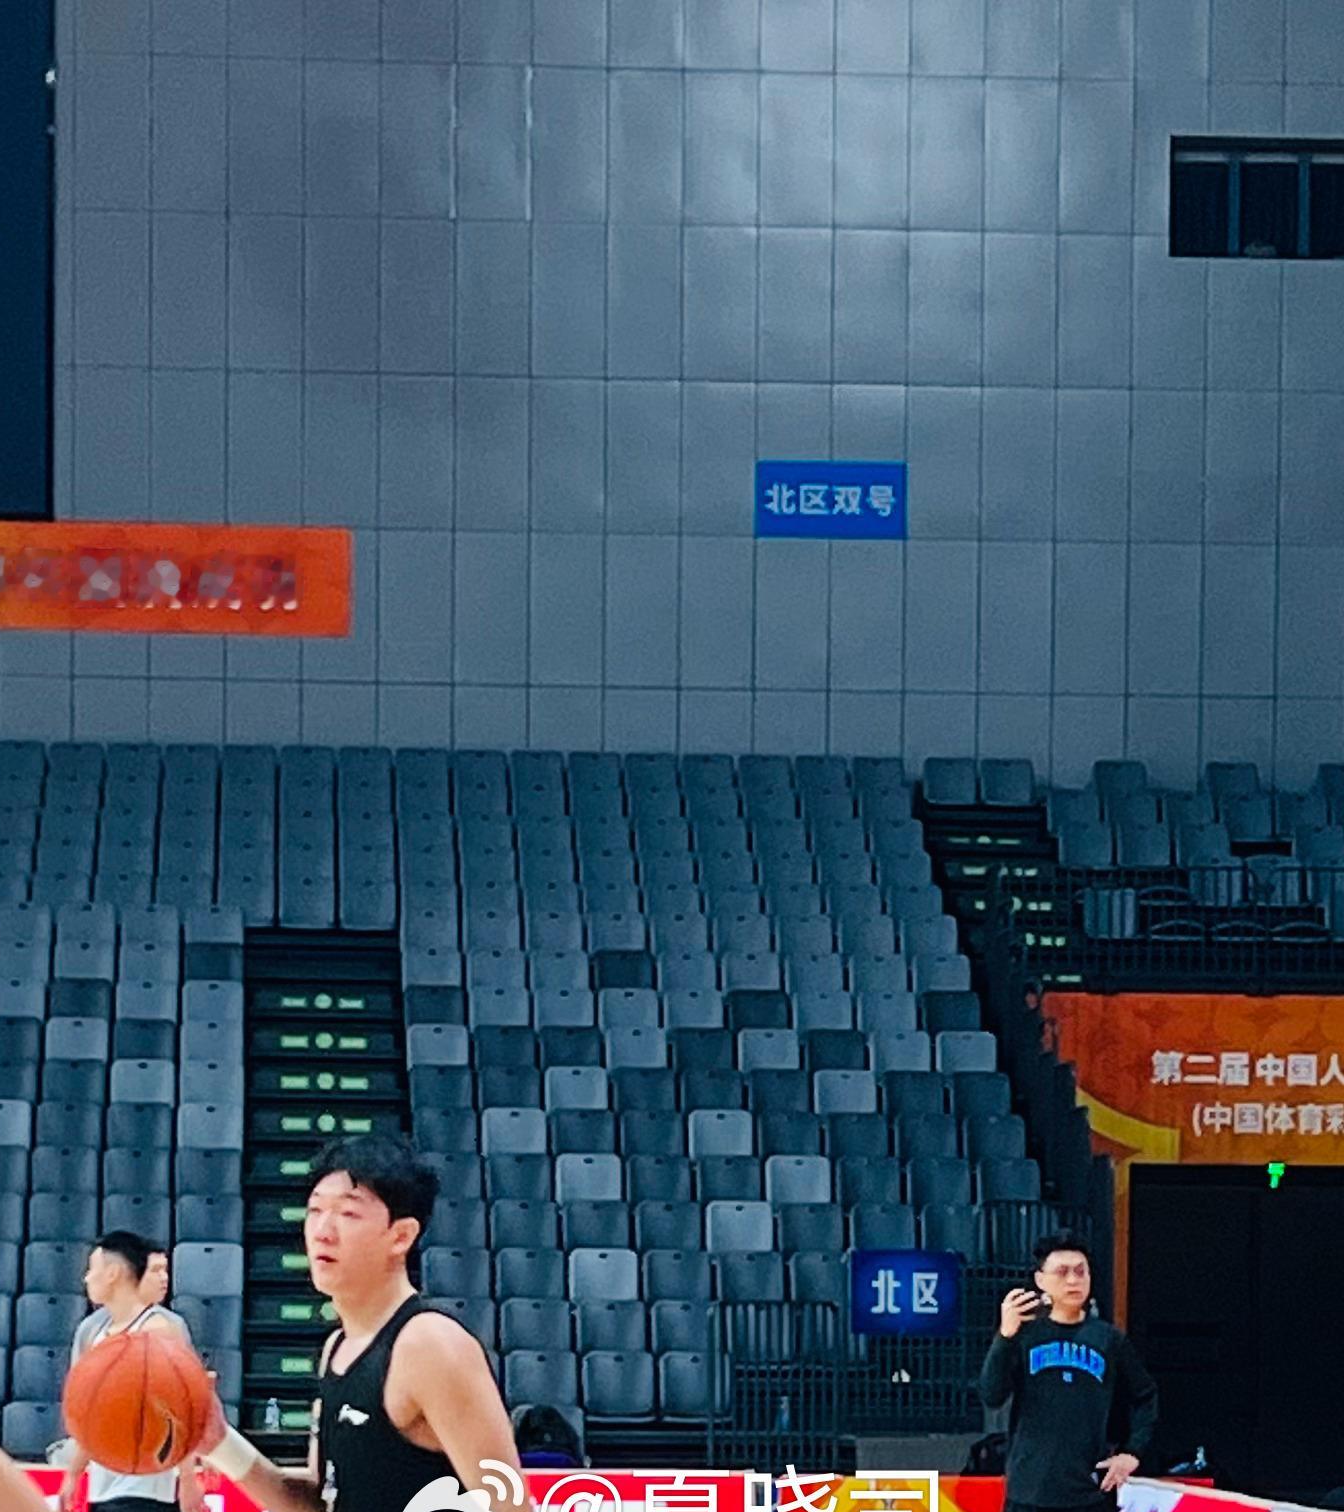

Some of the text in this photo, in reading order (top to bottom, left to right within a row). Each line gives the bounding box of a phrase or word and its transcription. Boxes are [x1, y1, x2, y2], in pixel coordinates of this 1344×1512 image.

[765, 480, 895, 516] 北区双号
[870, 1269, 939, 1314] 北区
